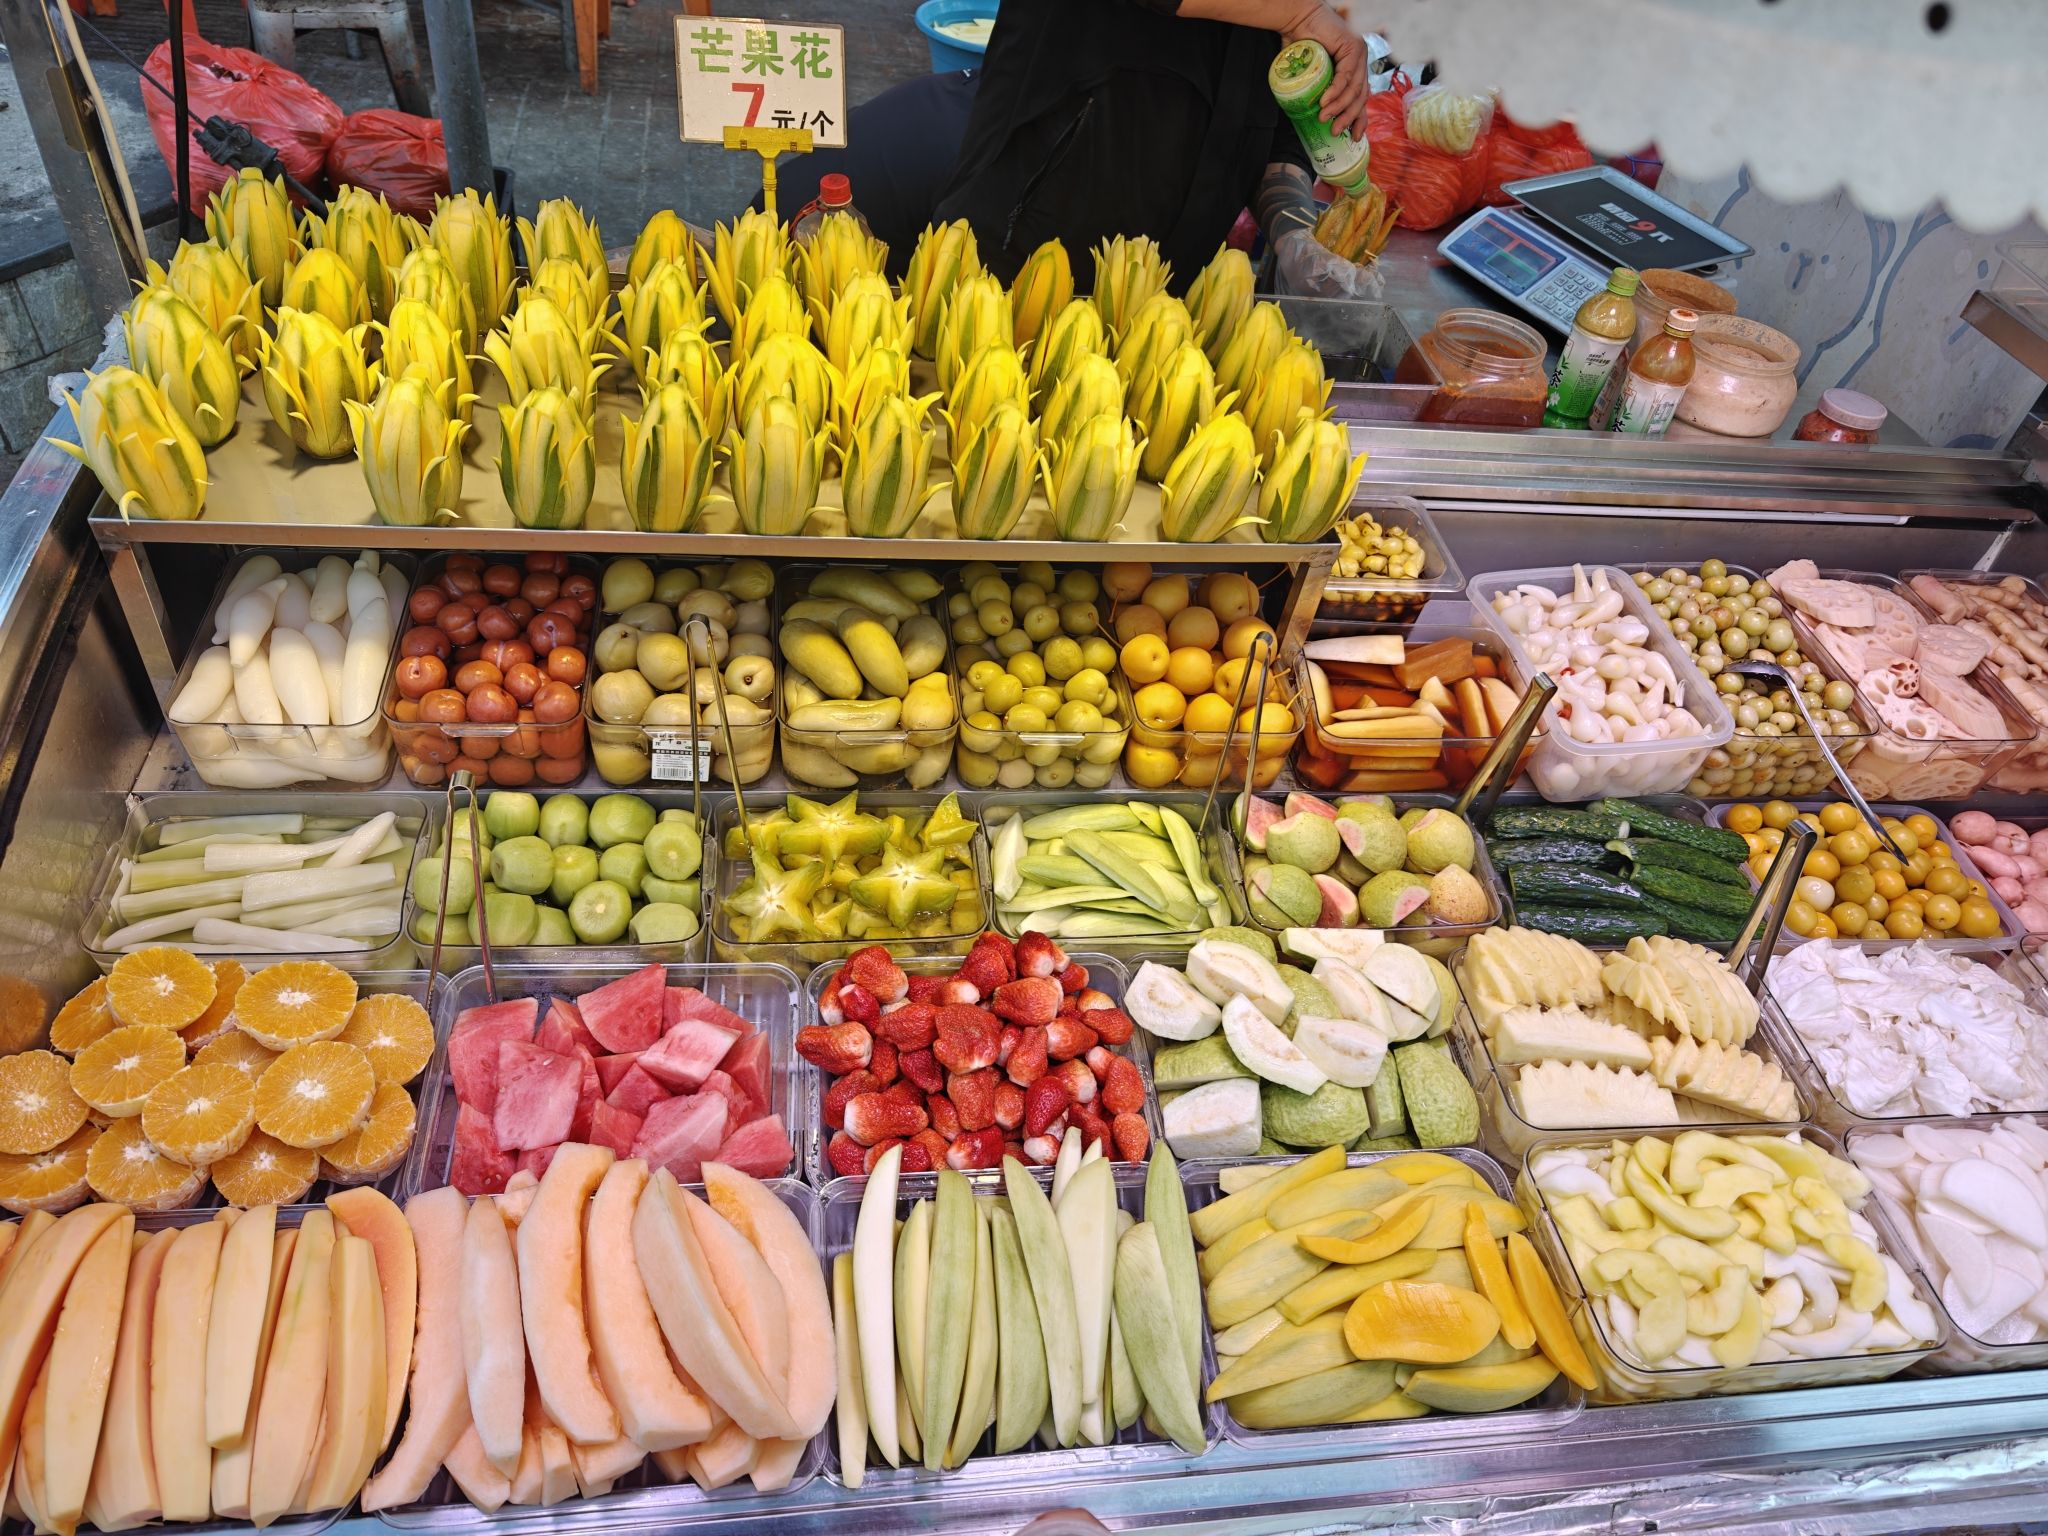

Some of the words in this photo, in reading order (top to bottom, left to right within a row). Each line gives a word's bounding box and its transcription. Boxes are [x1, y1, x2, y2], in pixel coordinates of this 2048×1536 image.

[690, 26, 833, 79] 芒果花
[731, 82, 765, 127] 7
